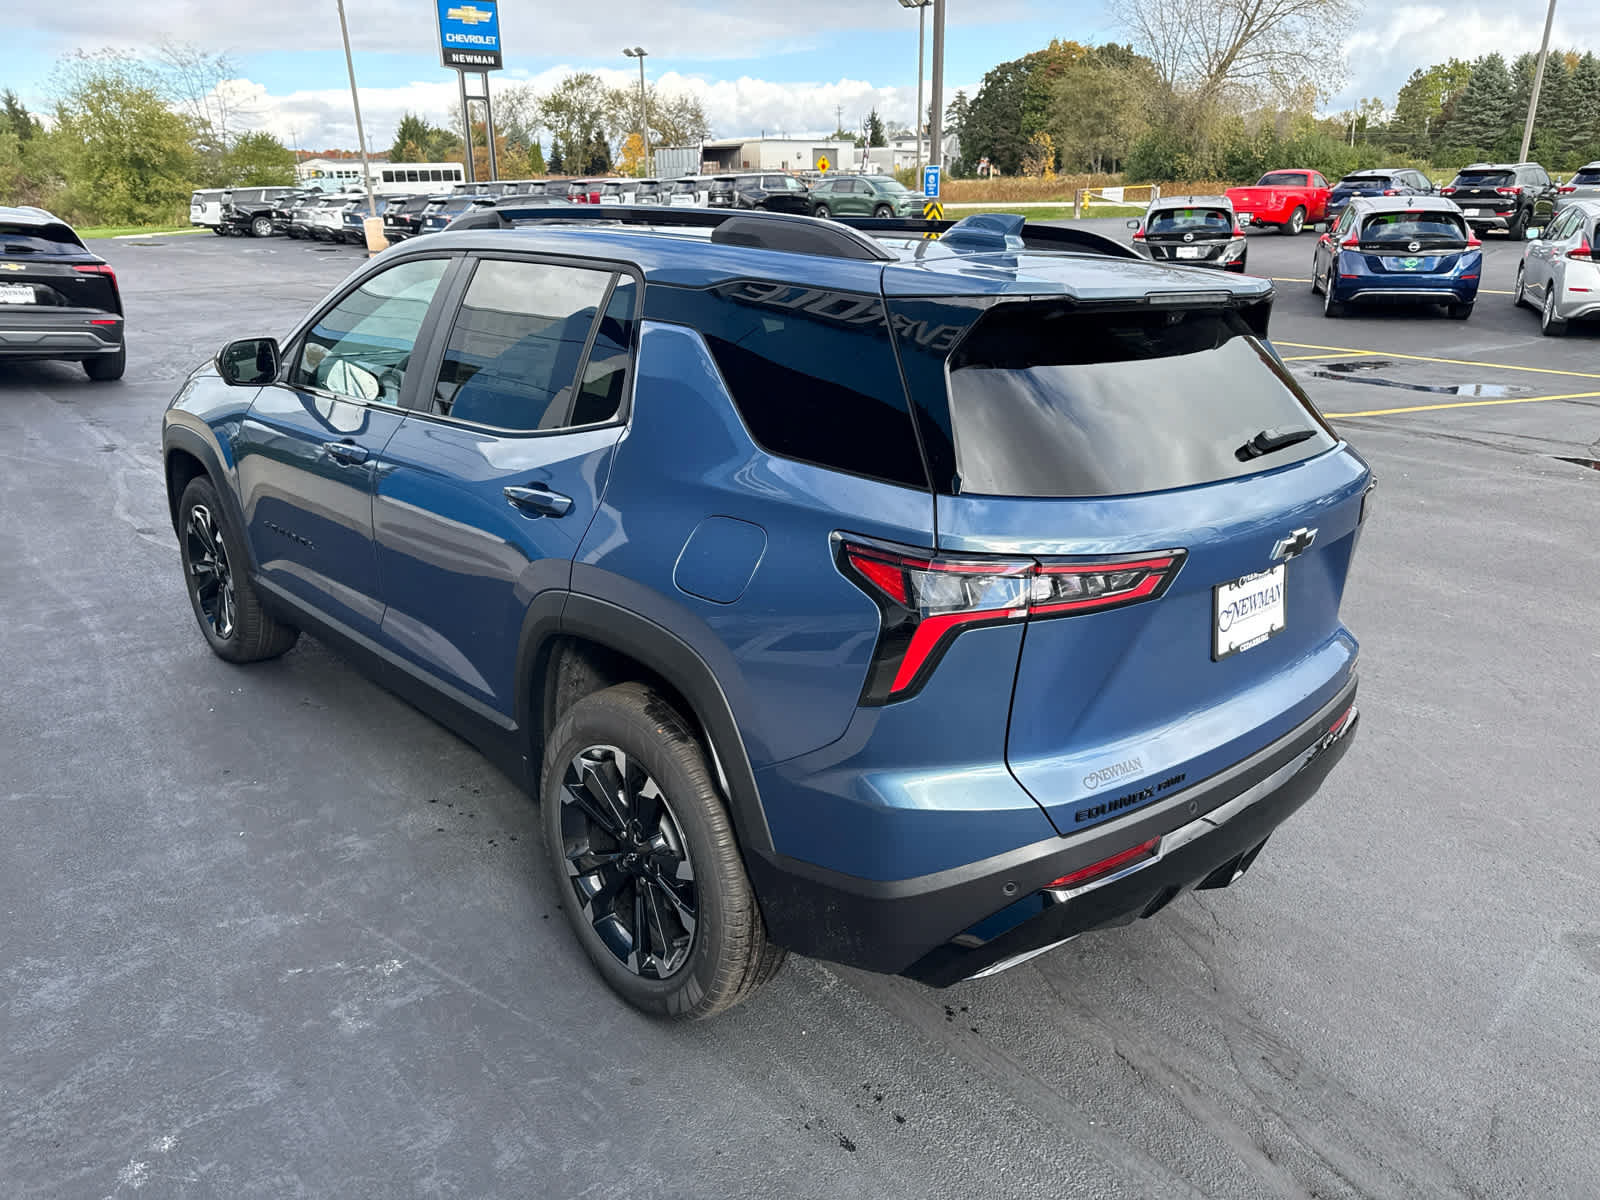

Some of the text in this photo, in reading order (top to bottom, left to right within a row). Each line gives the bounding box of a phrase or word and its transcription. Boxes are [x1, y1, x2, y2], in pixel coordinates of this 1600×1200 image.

[446, 33, 496, 45] CHEVROLET
[452, 53, 495, 64] NEWMAN
[1219, 582, 1283, 632] NEWMAN
[1083, 757, 1143, 790] NEWMAN
[1074, 786, 1154, 822] EQUINOX
